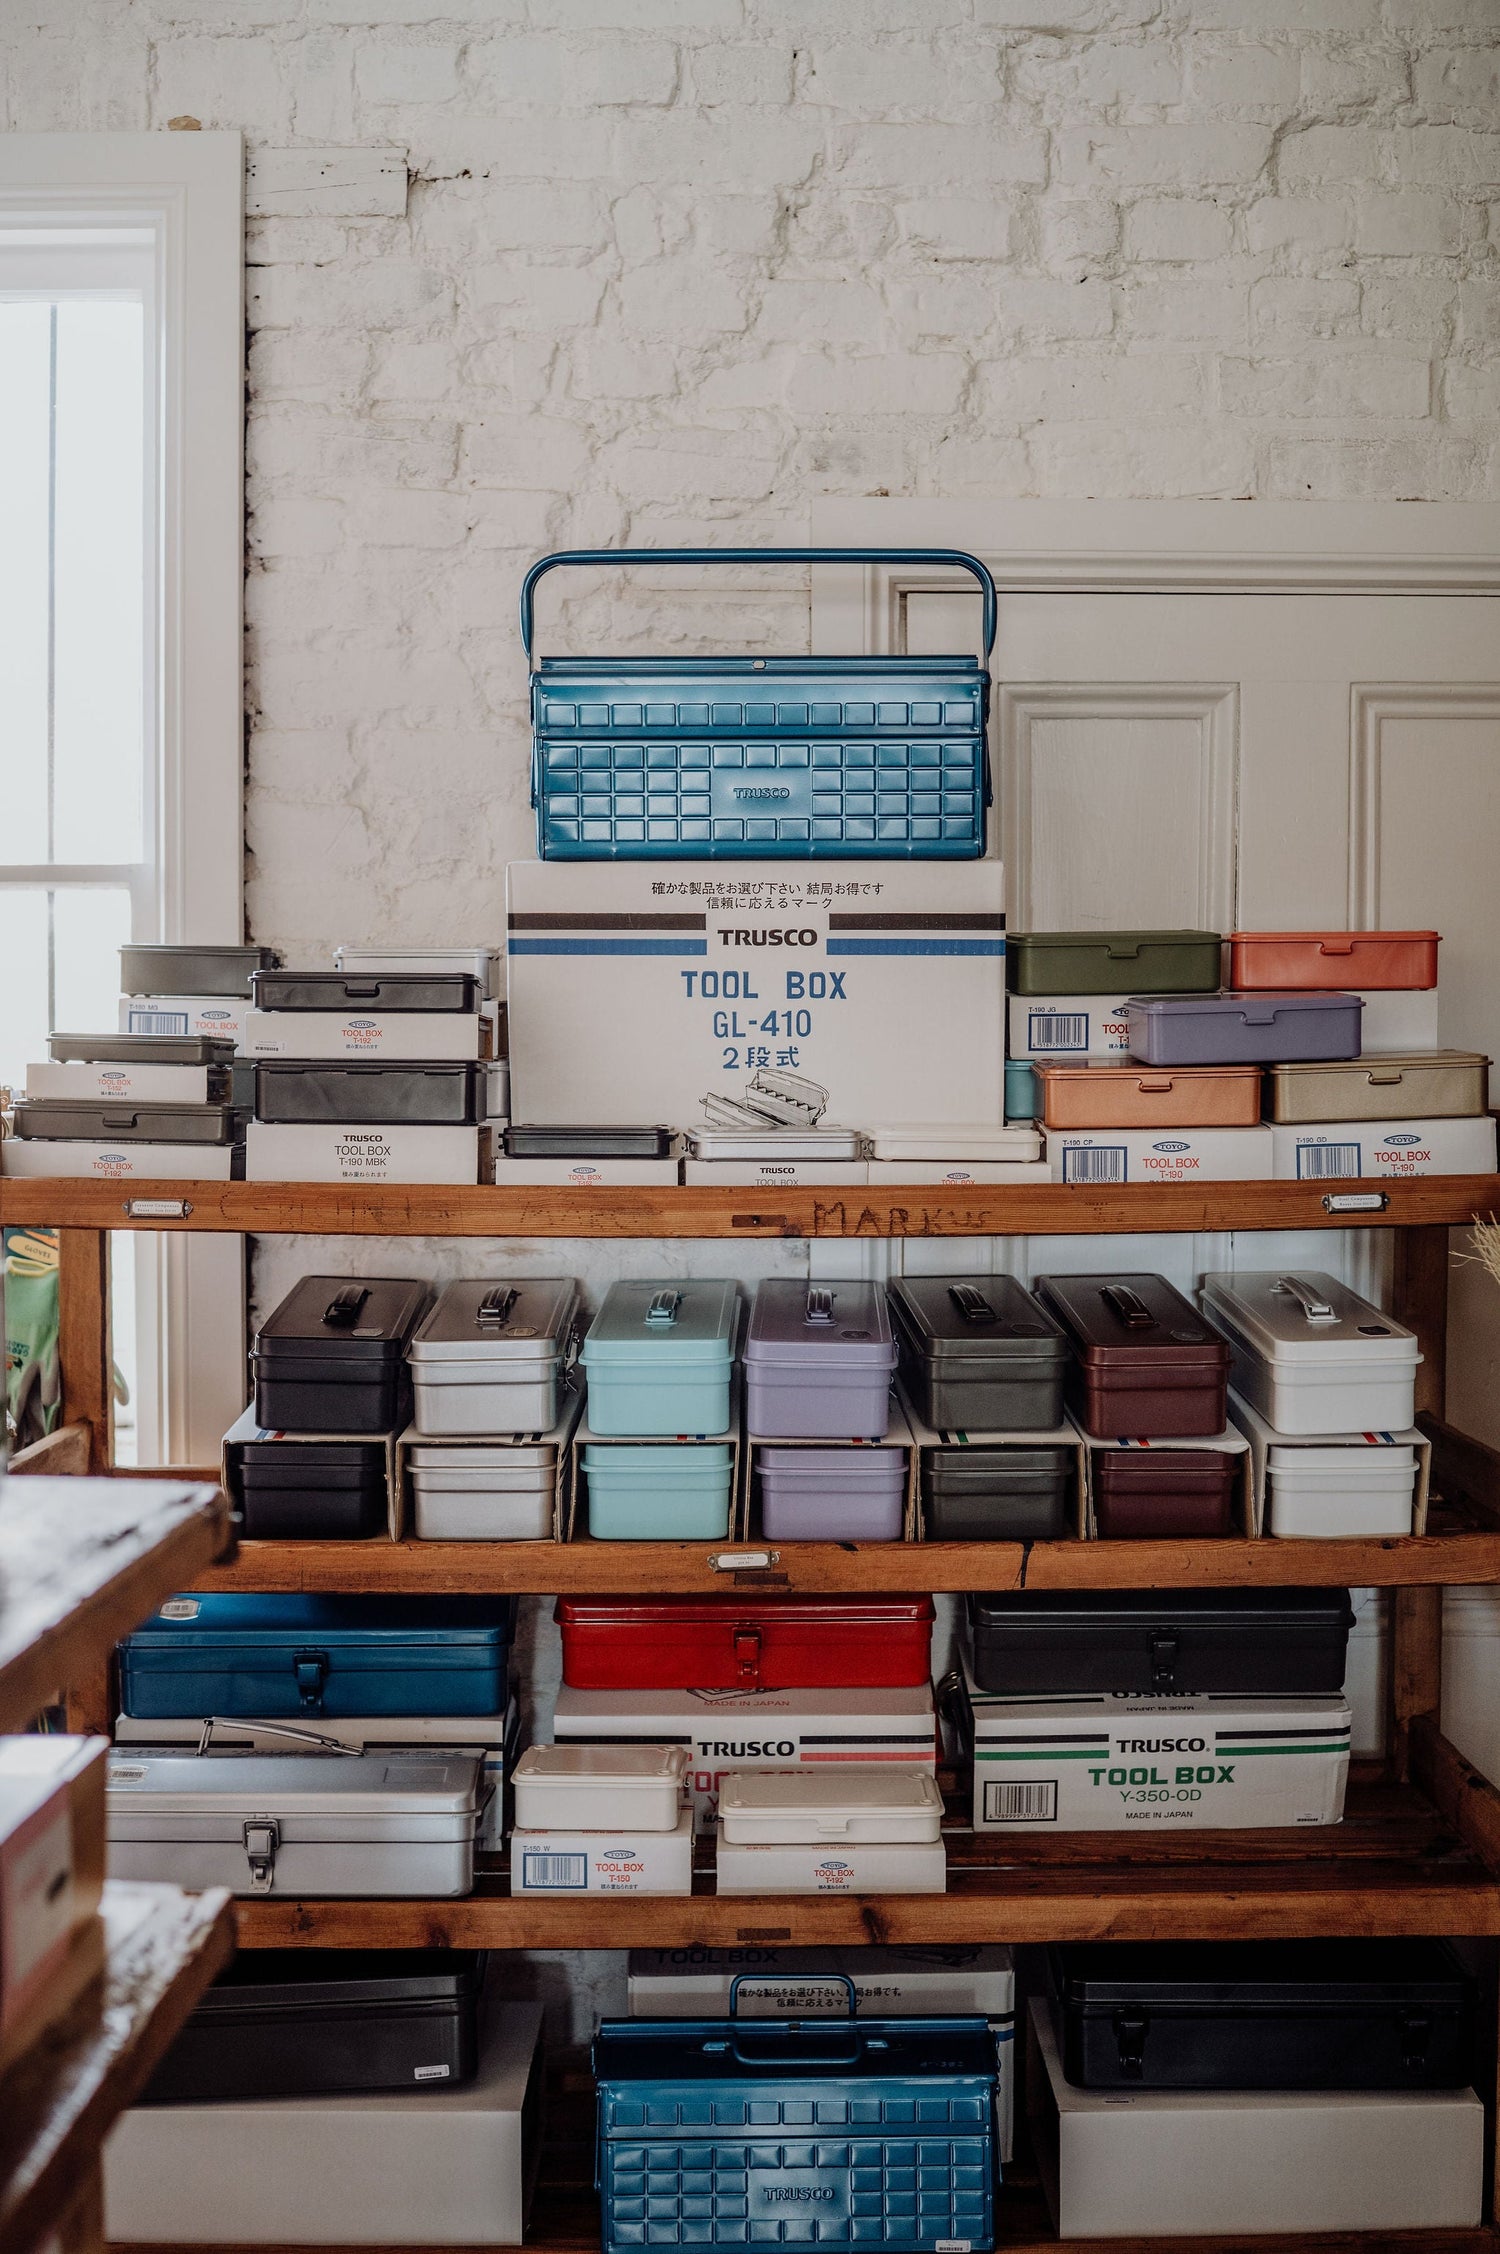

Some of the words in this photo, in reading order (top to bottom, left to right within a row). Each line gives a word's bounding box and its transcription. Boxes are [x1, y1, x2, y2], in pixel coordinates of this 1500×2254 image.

[733, 787, 790, 799] TRUSCO
[651, 882, 801, 896] 確かな製品をお選び下さい
[806, 882, 884, 896] 結局お得です
[706, 897, 832, 910] 信頼に応えるマーク
[717, 929, 818, 947] TRUSCO
[681, 970, 759, 999] TOOL
[786, 971, 847, 1000] BOX
[195, 1021, 217, 1030] TOOL
[219, 1022, 239, 1031] BOX
[713, 1009, 812, 1038] GL-410
[341, 1029, 364, 1037] TOOL
[366, 1029, 383, 1037] BOX
[722, 1046, 800, 1069] 2段式
[343, 1134, 383, 1143] TRUSCO
[334, 1145, 365, 1156] TOOL
[367, 1145, 391, 1156] BOX
[1374, 1151, 1405, 1162] TOOL
[1407, 1150, 1431, 1161] BOX
[92, 1162, 115, 1170] TOOL
[116, 1163, 133, 1171] BOX
[339, 1157, 363, 1166] T-190
[365, 1158, 387, 1166] MBK
[1142, 1158, 1174, 1169] TOOL
[1175, 1158, 1200, 1169] BOX
[760, 1167, 795, 1175] TRUSCO
[1391, 1164, 1414, 1172] T-190
[1159, 1170, 1183, 1179] T-190
[755, 1178, 780, 1187] TOOL
[781, 1178, 799, 1187] BOX
[697, 1741, 795, 1757] TRUSCO
[1116, 1738, 1206, 1754] TRUSCO
[1088, 1767, 1168, 1786] TOOL
[1175, 1765, 1236, 1785] BOX
[1120, 1789, 1202, 1803] Y-350-OD
[1125, 1811, 1152, 1819] MADE
[595, 1863, 622, 1872] TOOL
[623, 1863, 644, 1872] BOX
[813, 1869, 836, 1877] TOOL
[837, 1869, 855, 1877] BOX
[609, 1875, 630, 1883] T-150
[654, 1949, 720, 1964] TOOL
[728, 1949, 778, 1963] BOX
[763, 2187, 835, 2201] TRUSCO
